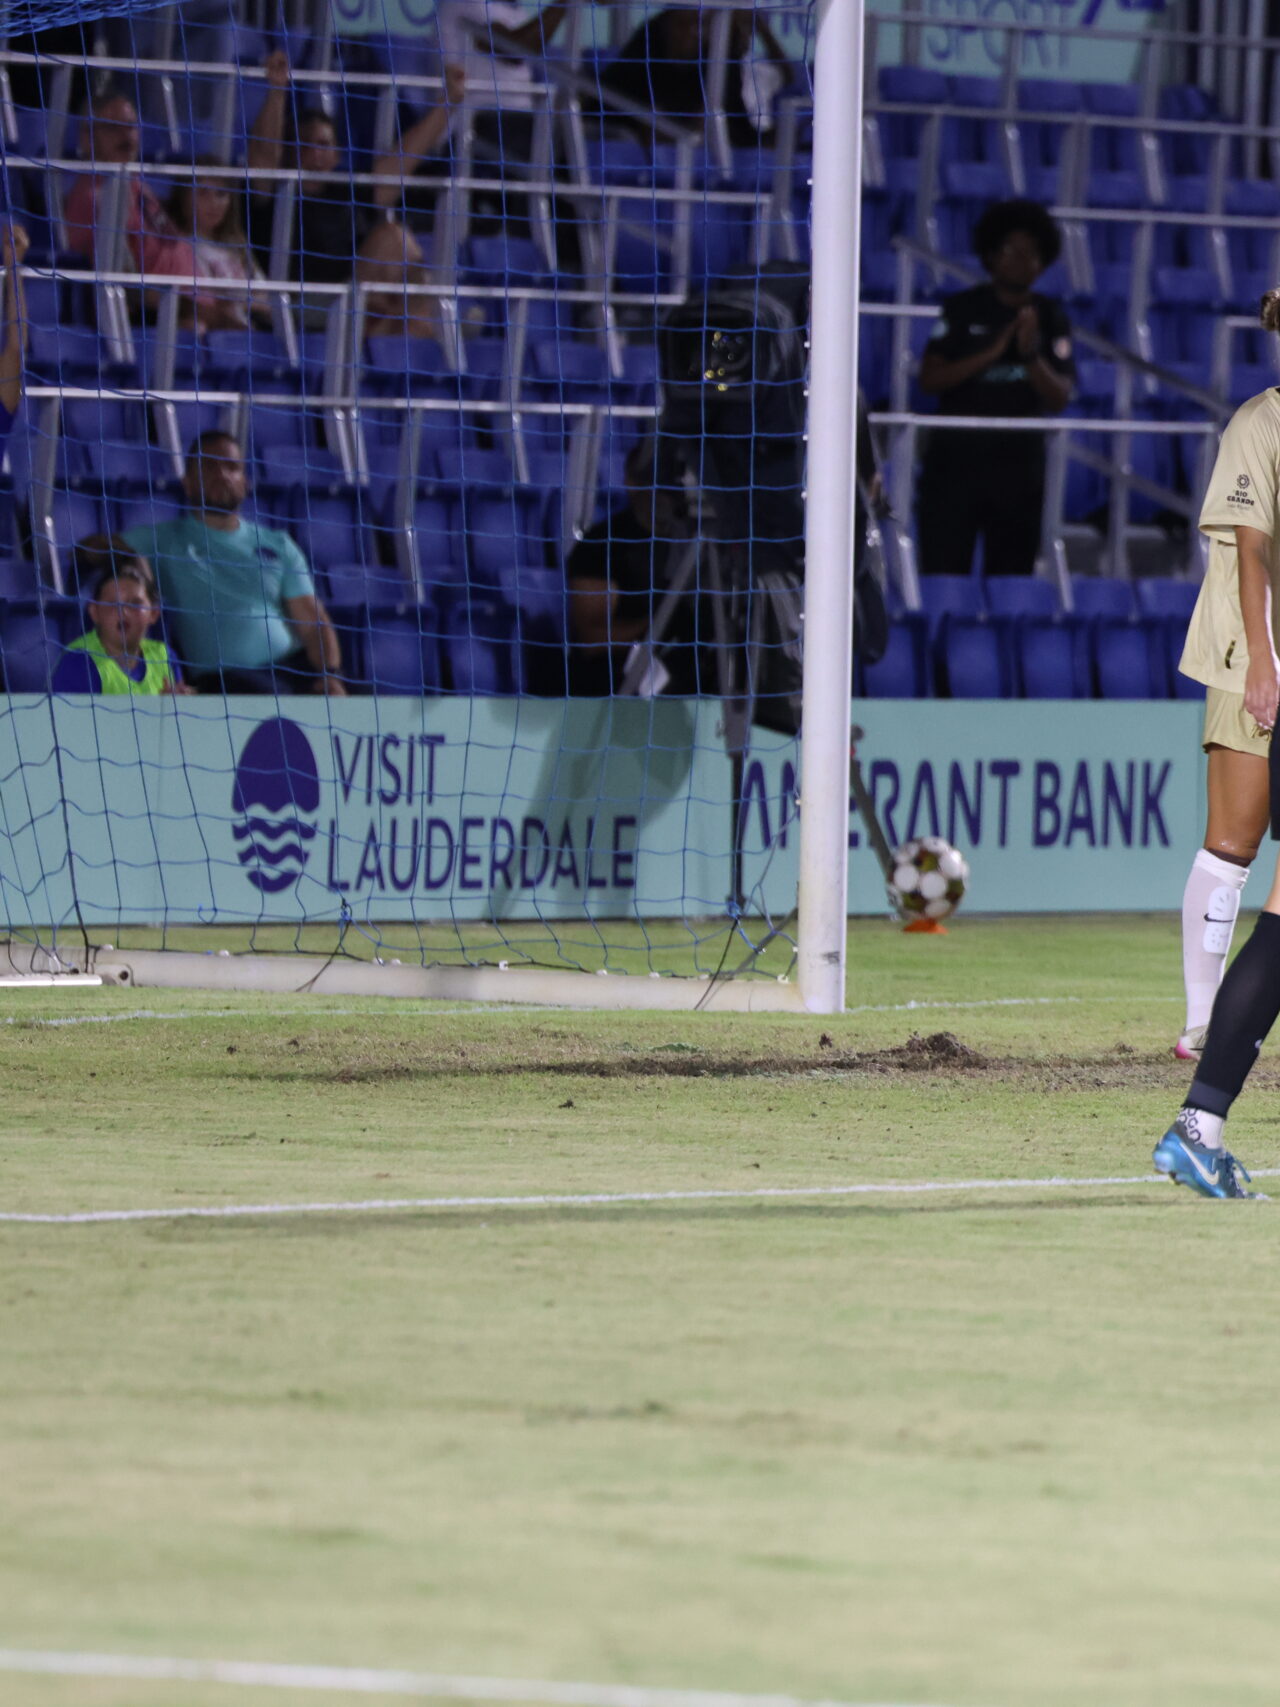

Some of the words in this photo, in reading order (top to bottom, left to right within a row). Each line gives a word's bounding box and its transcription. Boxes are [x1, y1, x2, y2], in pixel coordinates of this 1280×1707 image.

[334, 733, 446, 807] VISIT
[1033, 760, 1172, 849] BANK
[328, 816, 637, 892] LAUDERDALE
